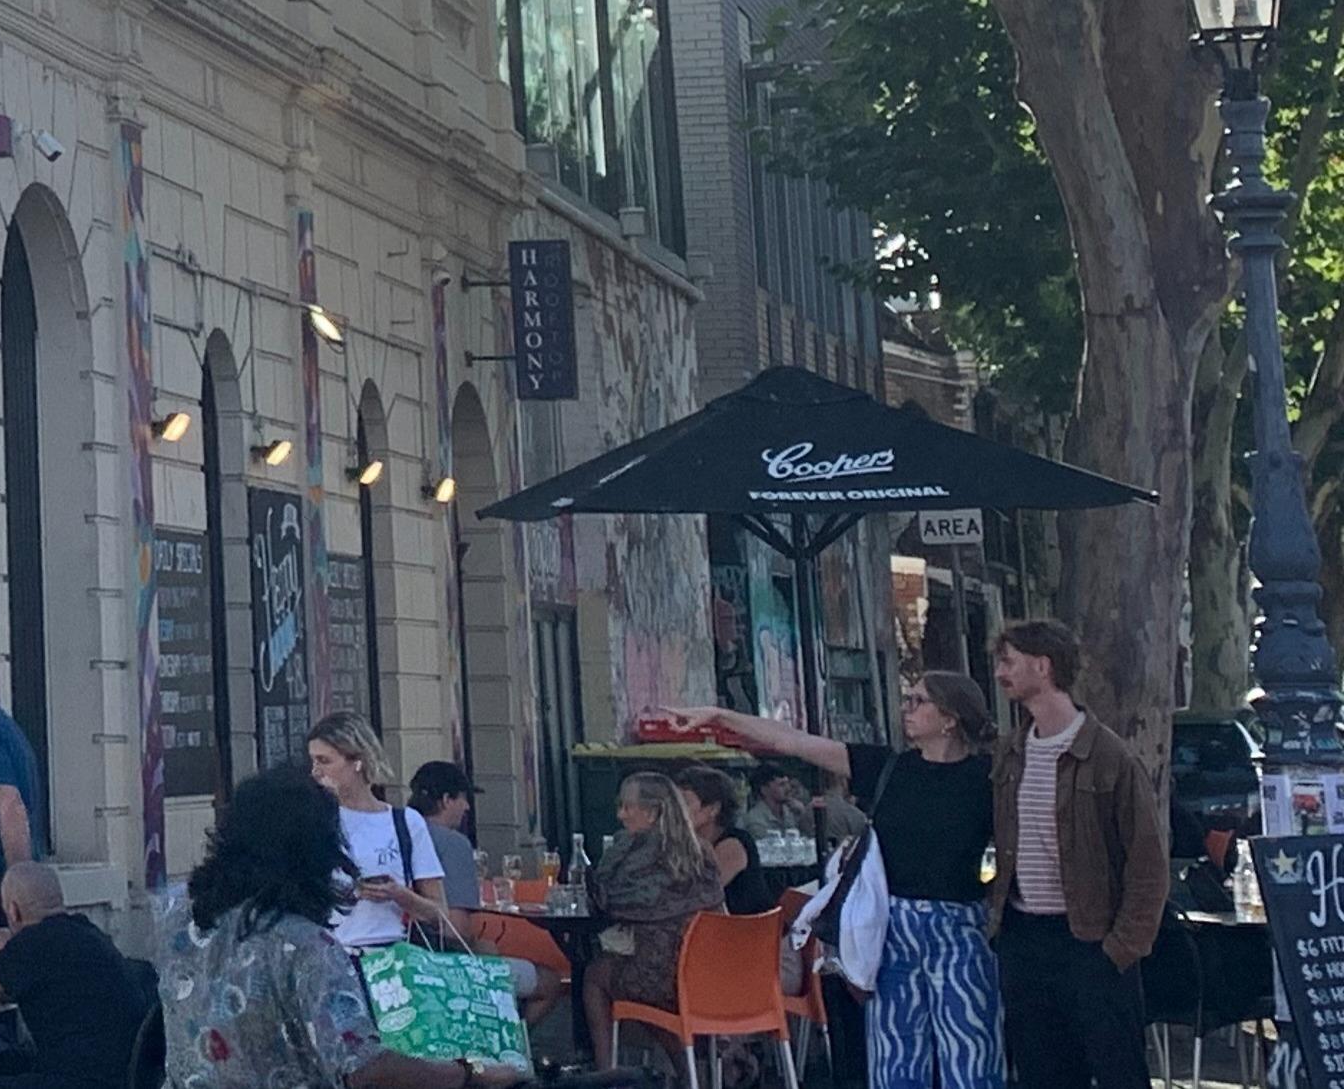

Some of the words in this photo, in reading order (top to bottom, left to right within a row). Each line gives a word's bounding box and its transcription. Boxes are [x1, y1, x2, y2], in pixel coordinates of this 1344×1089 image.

[520, 248, 545, 391] HARMONY
[761, 442, 895, 482] Coopers
[749, 489, 846, 501] FOREVER
[847, 486, 950, 500] ORIGINAL
[923, 518, 981, 537] AREA
[1296, 937, 1320, 958] $6
[1301, 962, 1324, 982] $6
